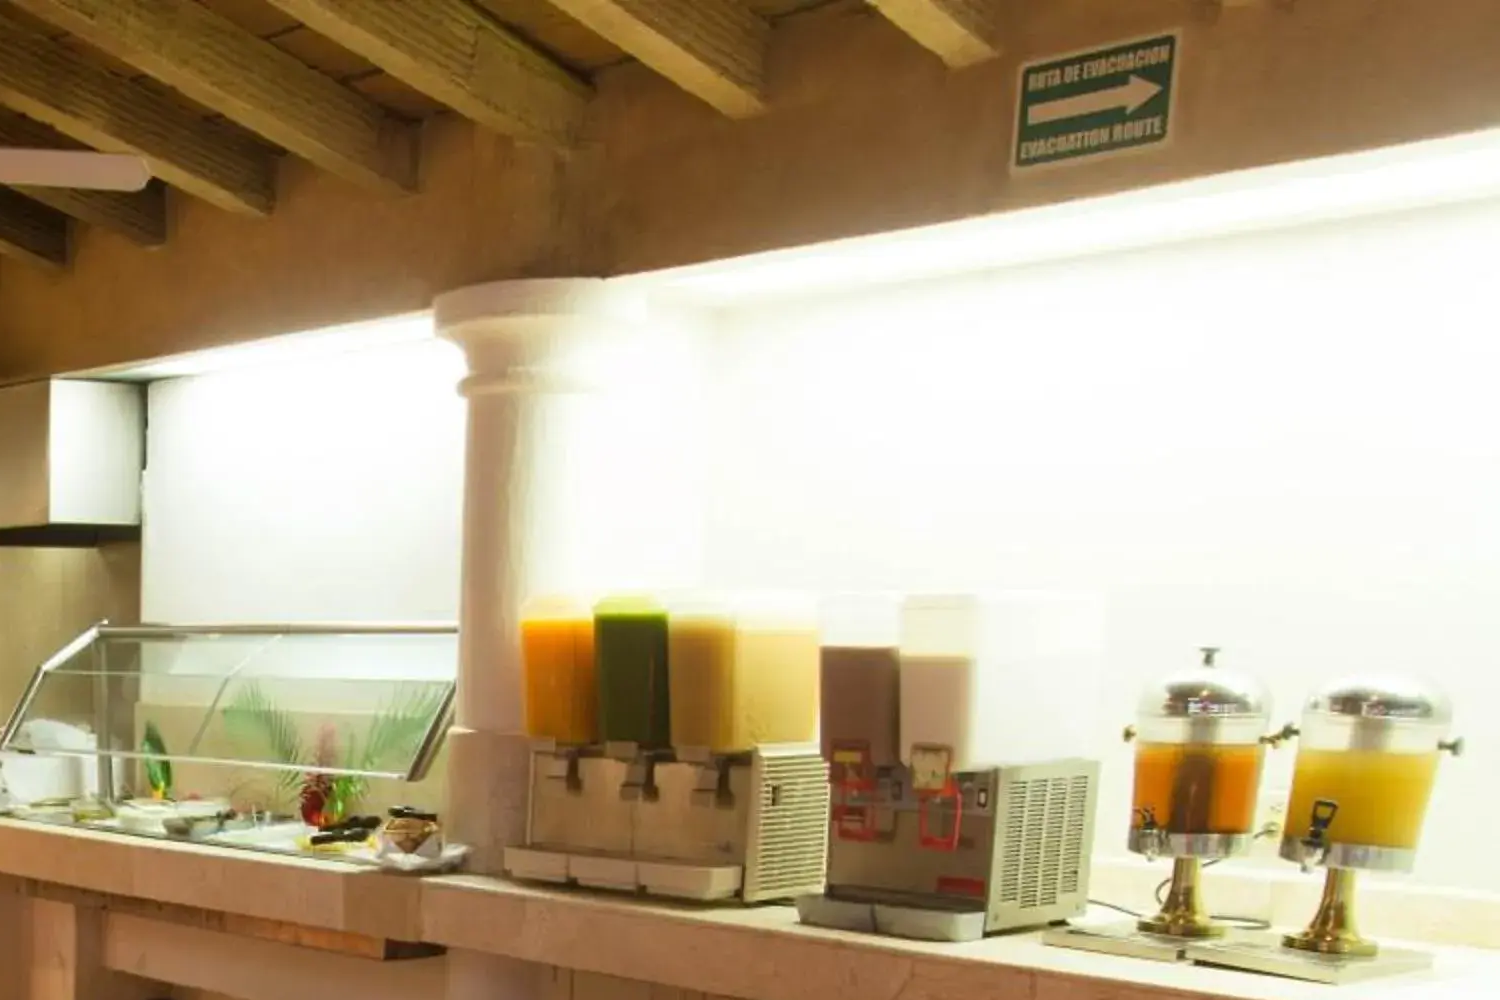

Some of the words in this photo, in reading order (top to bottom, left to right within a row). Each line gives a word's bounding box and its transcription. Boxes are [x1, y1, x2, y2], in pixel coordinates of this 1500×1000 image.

[1028, 69, 1061, 91] RUTA
[1064, 63, 1082, 84] DE
[1020, 127, 1110, 159] EVACUATION
[1112, 116, 1163, 142] ROUTE
